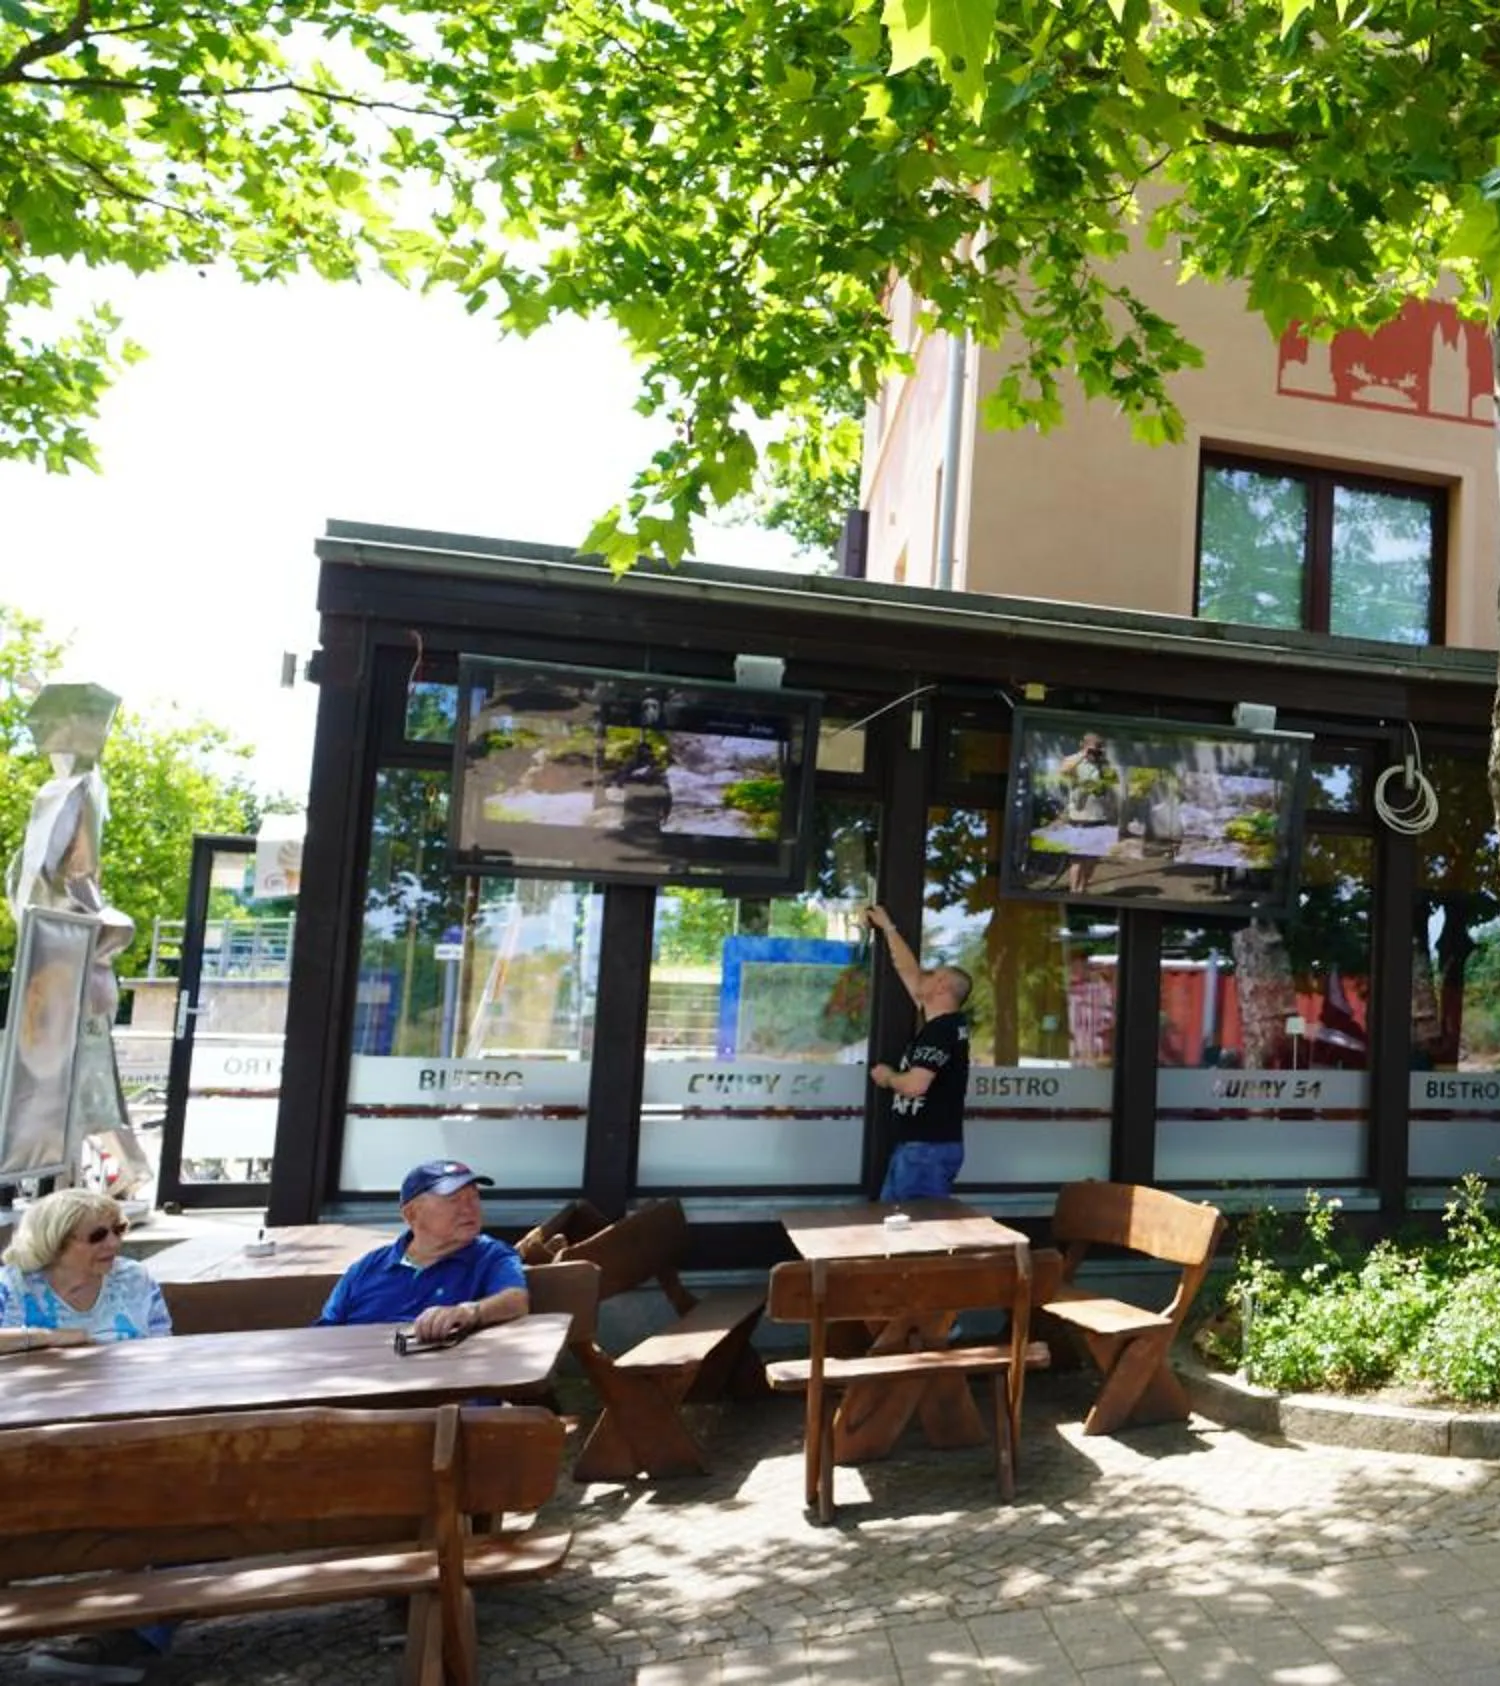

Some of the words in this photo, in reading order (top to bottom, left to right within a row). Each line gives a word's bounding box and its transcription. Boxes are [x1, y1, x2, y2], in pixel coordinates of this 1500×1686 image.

[418, 1069, 525, 1092] BISTRO
[975, 1076, 1061, 1097] BISTRO
[1426, 1080, 1500, 1099] BISTRO
